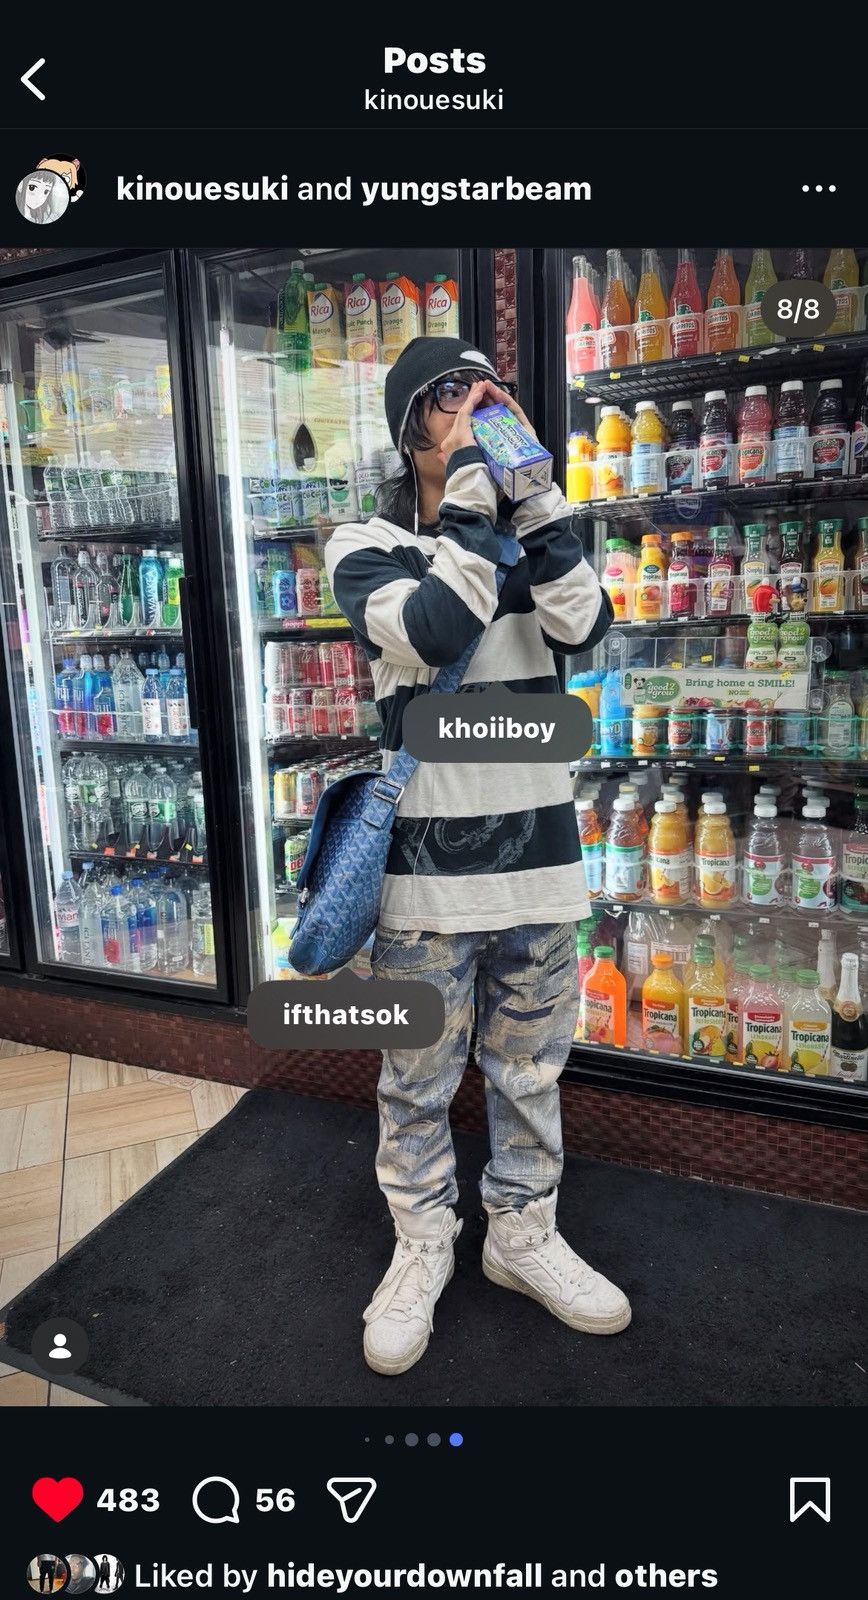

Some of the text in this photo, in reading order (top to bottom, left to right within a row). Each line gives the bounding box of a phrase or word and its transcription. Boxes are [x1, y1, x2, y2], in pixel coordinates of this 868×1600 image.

[347, 297, 366, 309] Rica
[382, 295, 401, 307] Rica
[428, 298, 447, 309] Rica
[310, 305, 330, 317] Rica
[428, 321, 447, 329] Orange
[685, 679, 715, 688] Bring
[717, 679, 745, 687] home
[758, 679, 795, 688] SMILE!
[702, 858, 730, 867] Tropicana
[845, 853, 868, 865] Tropic
[644, 1008, 677, 1021] Tropicana
[691, 1007, 726, 1018] Tropicana
[745, 1022, 782, 1034] Tropicana
[791, 1030, 830, 1043] Tropicana
